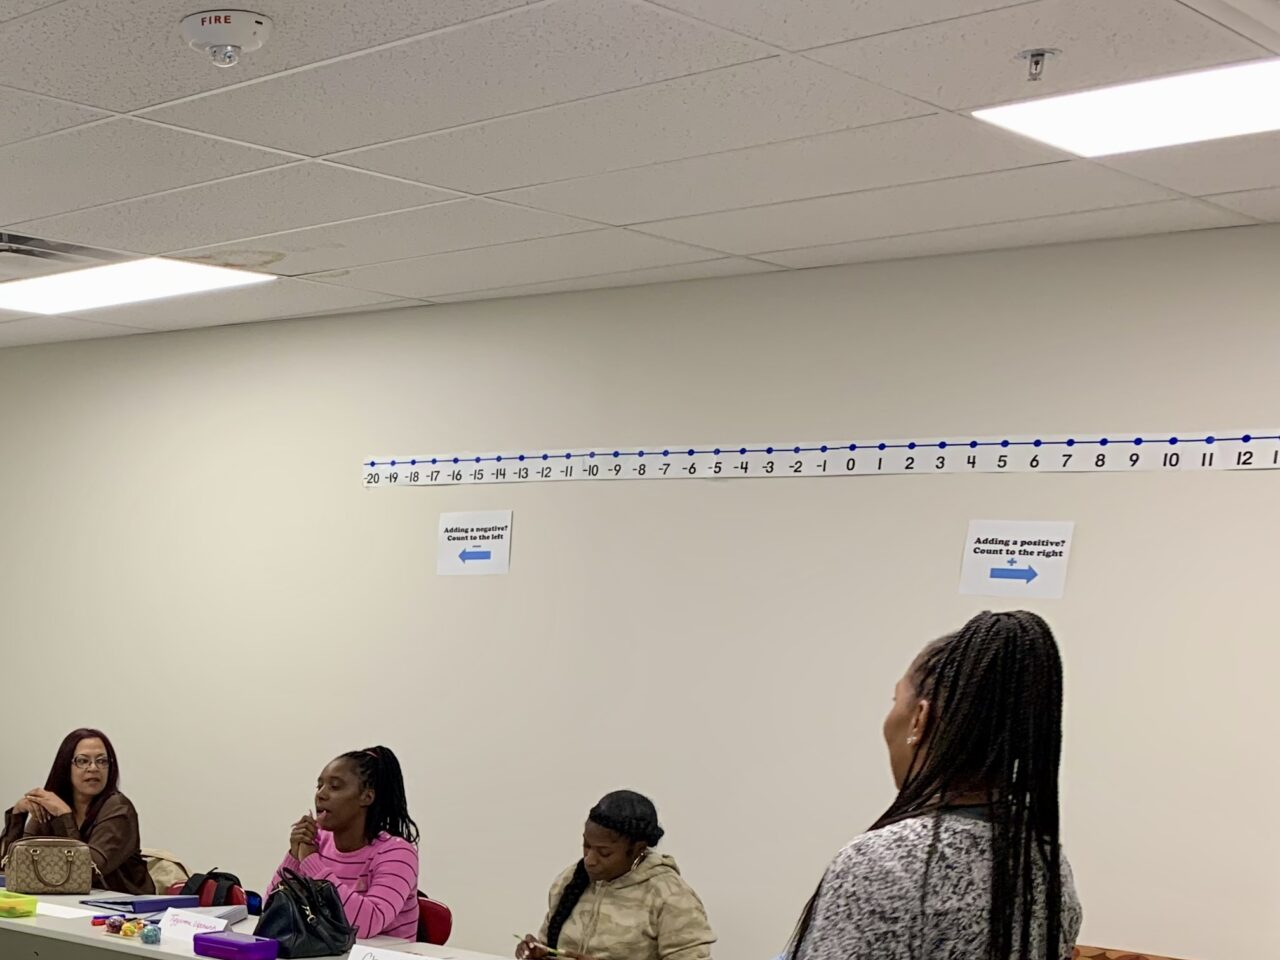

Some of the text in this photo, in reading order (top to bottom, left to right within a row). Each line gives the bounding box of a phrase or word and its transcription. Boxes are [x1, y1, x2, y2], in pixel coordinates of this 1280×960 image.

[201, 15, 232, 26] FIRE
[364, 451, 1254, 484] -20 -19 -18 -17 -16 -15 -14 -13 -12 -11 -10 -9 -8 -7 -6 -5 -4 -3 -2 -1 0 1 2 3 4 5 6 7 8 9 10 11 12
[974, 538, 1010, 547] Adding
[1020, 539, 1066, 548] positive?
[1037, 550, 1063, 558] right
